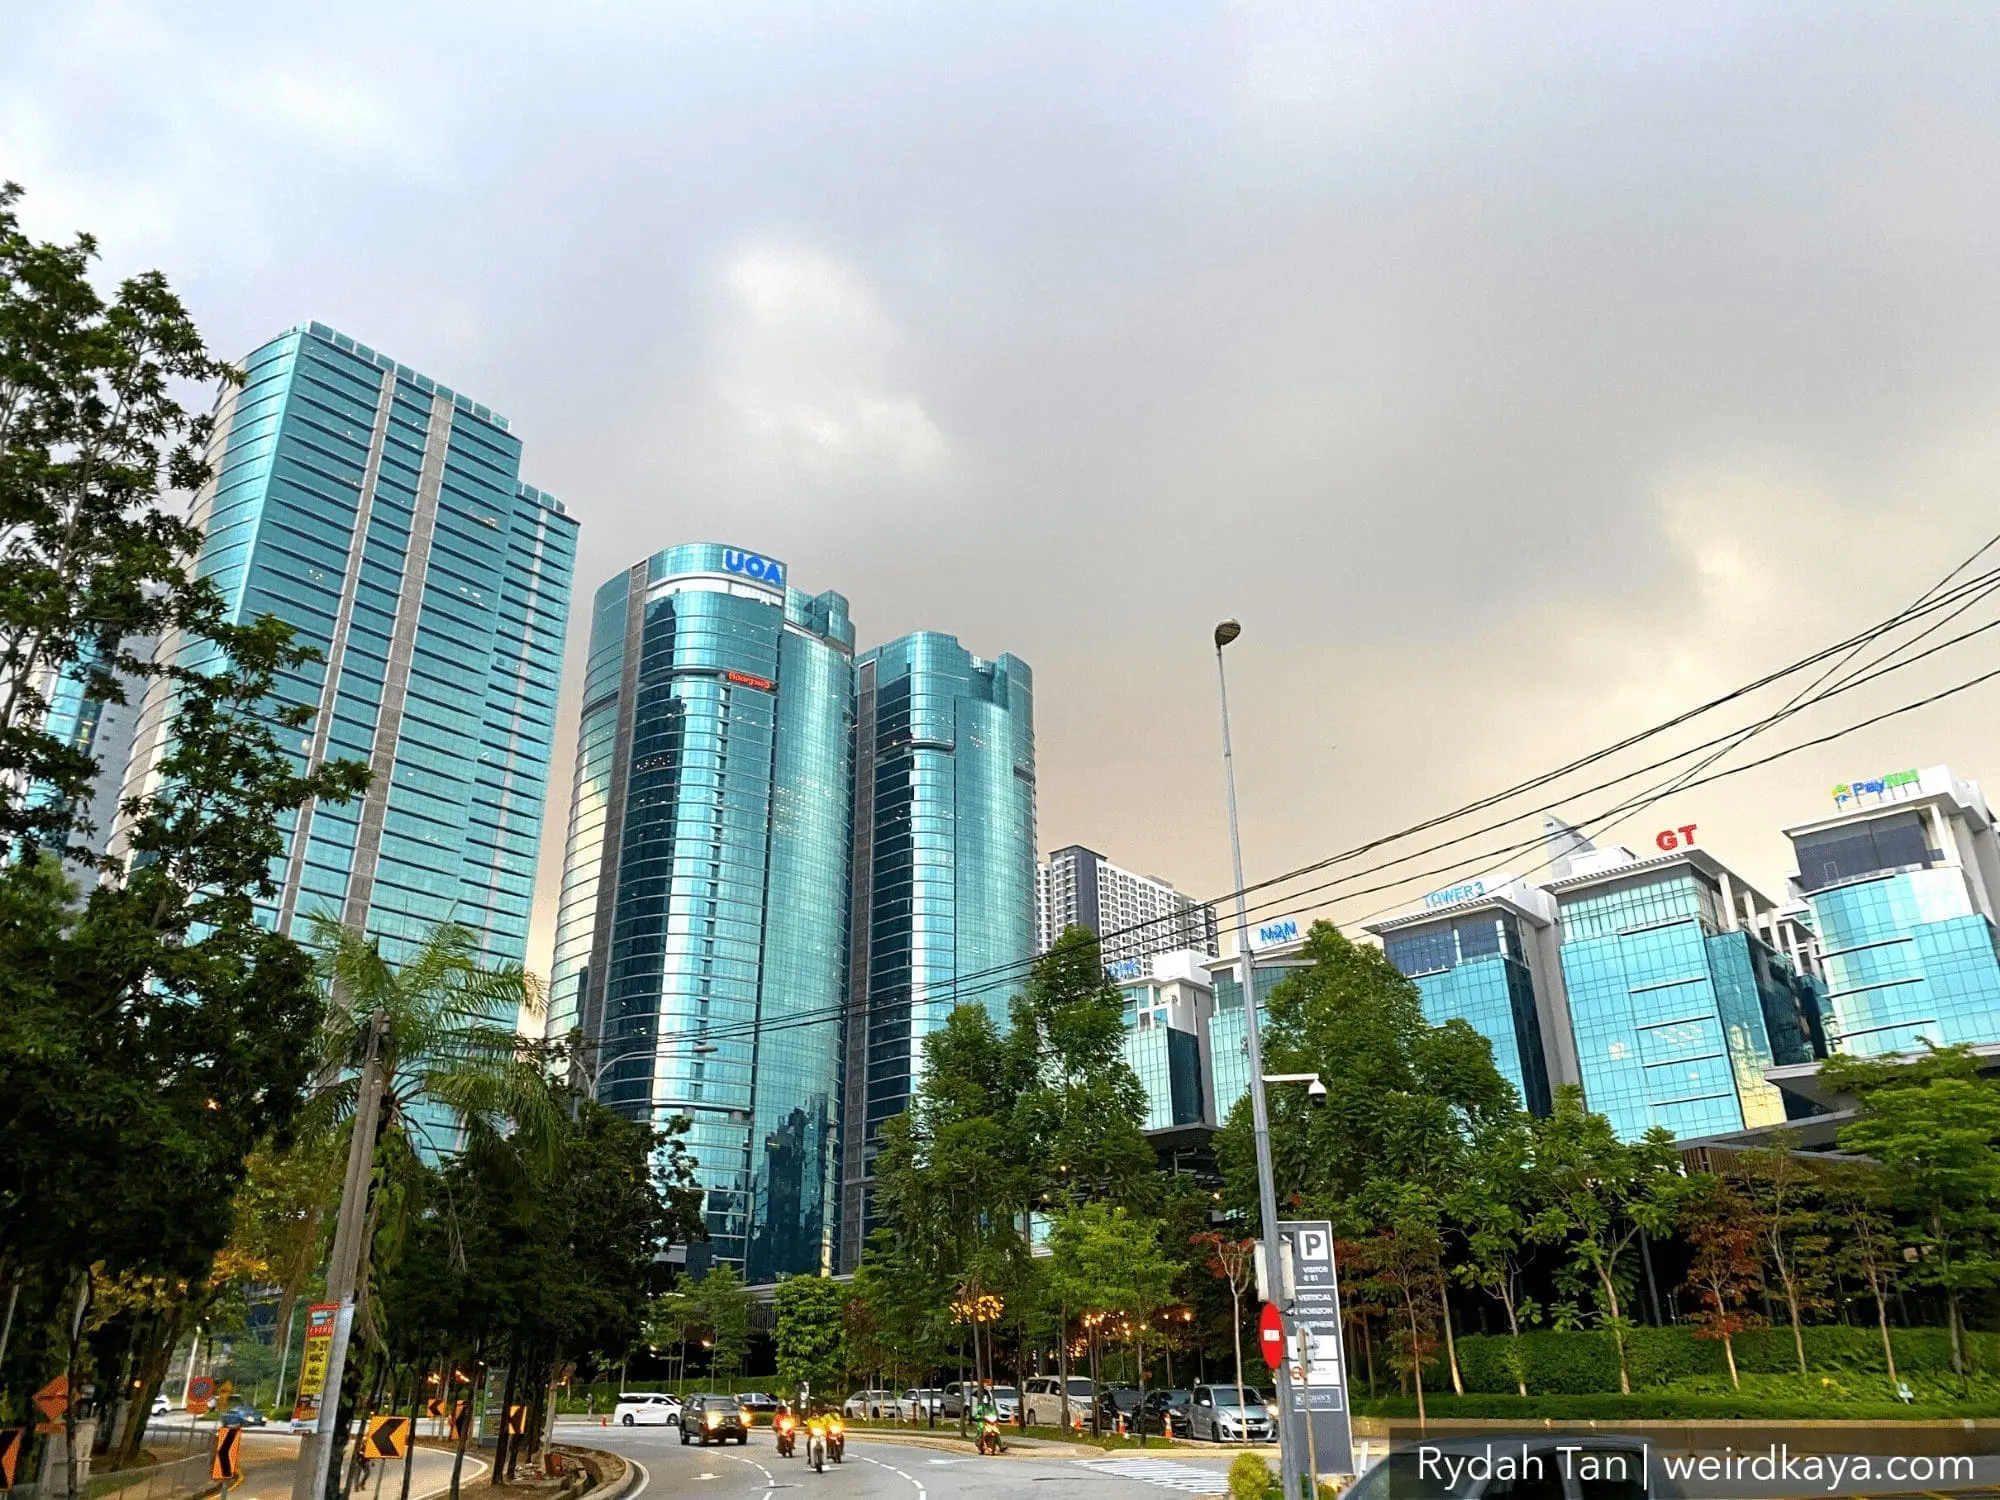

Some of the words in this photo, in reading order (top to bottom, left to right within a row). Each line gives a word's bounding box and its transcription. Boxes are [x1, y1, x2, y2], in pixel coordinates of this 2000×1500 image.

[725, 550, 783, 585] UOA
[1656, 824, 1697, 850] GT
[1423, 886, 1475, 908] TOWER
[1475, 882, 1484, 896] 3
[1304, 1233, 1321, 1256] P
[1299, 1307, 1333, 1315] HORIZON
